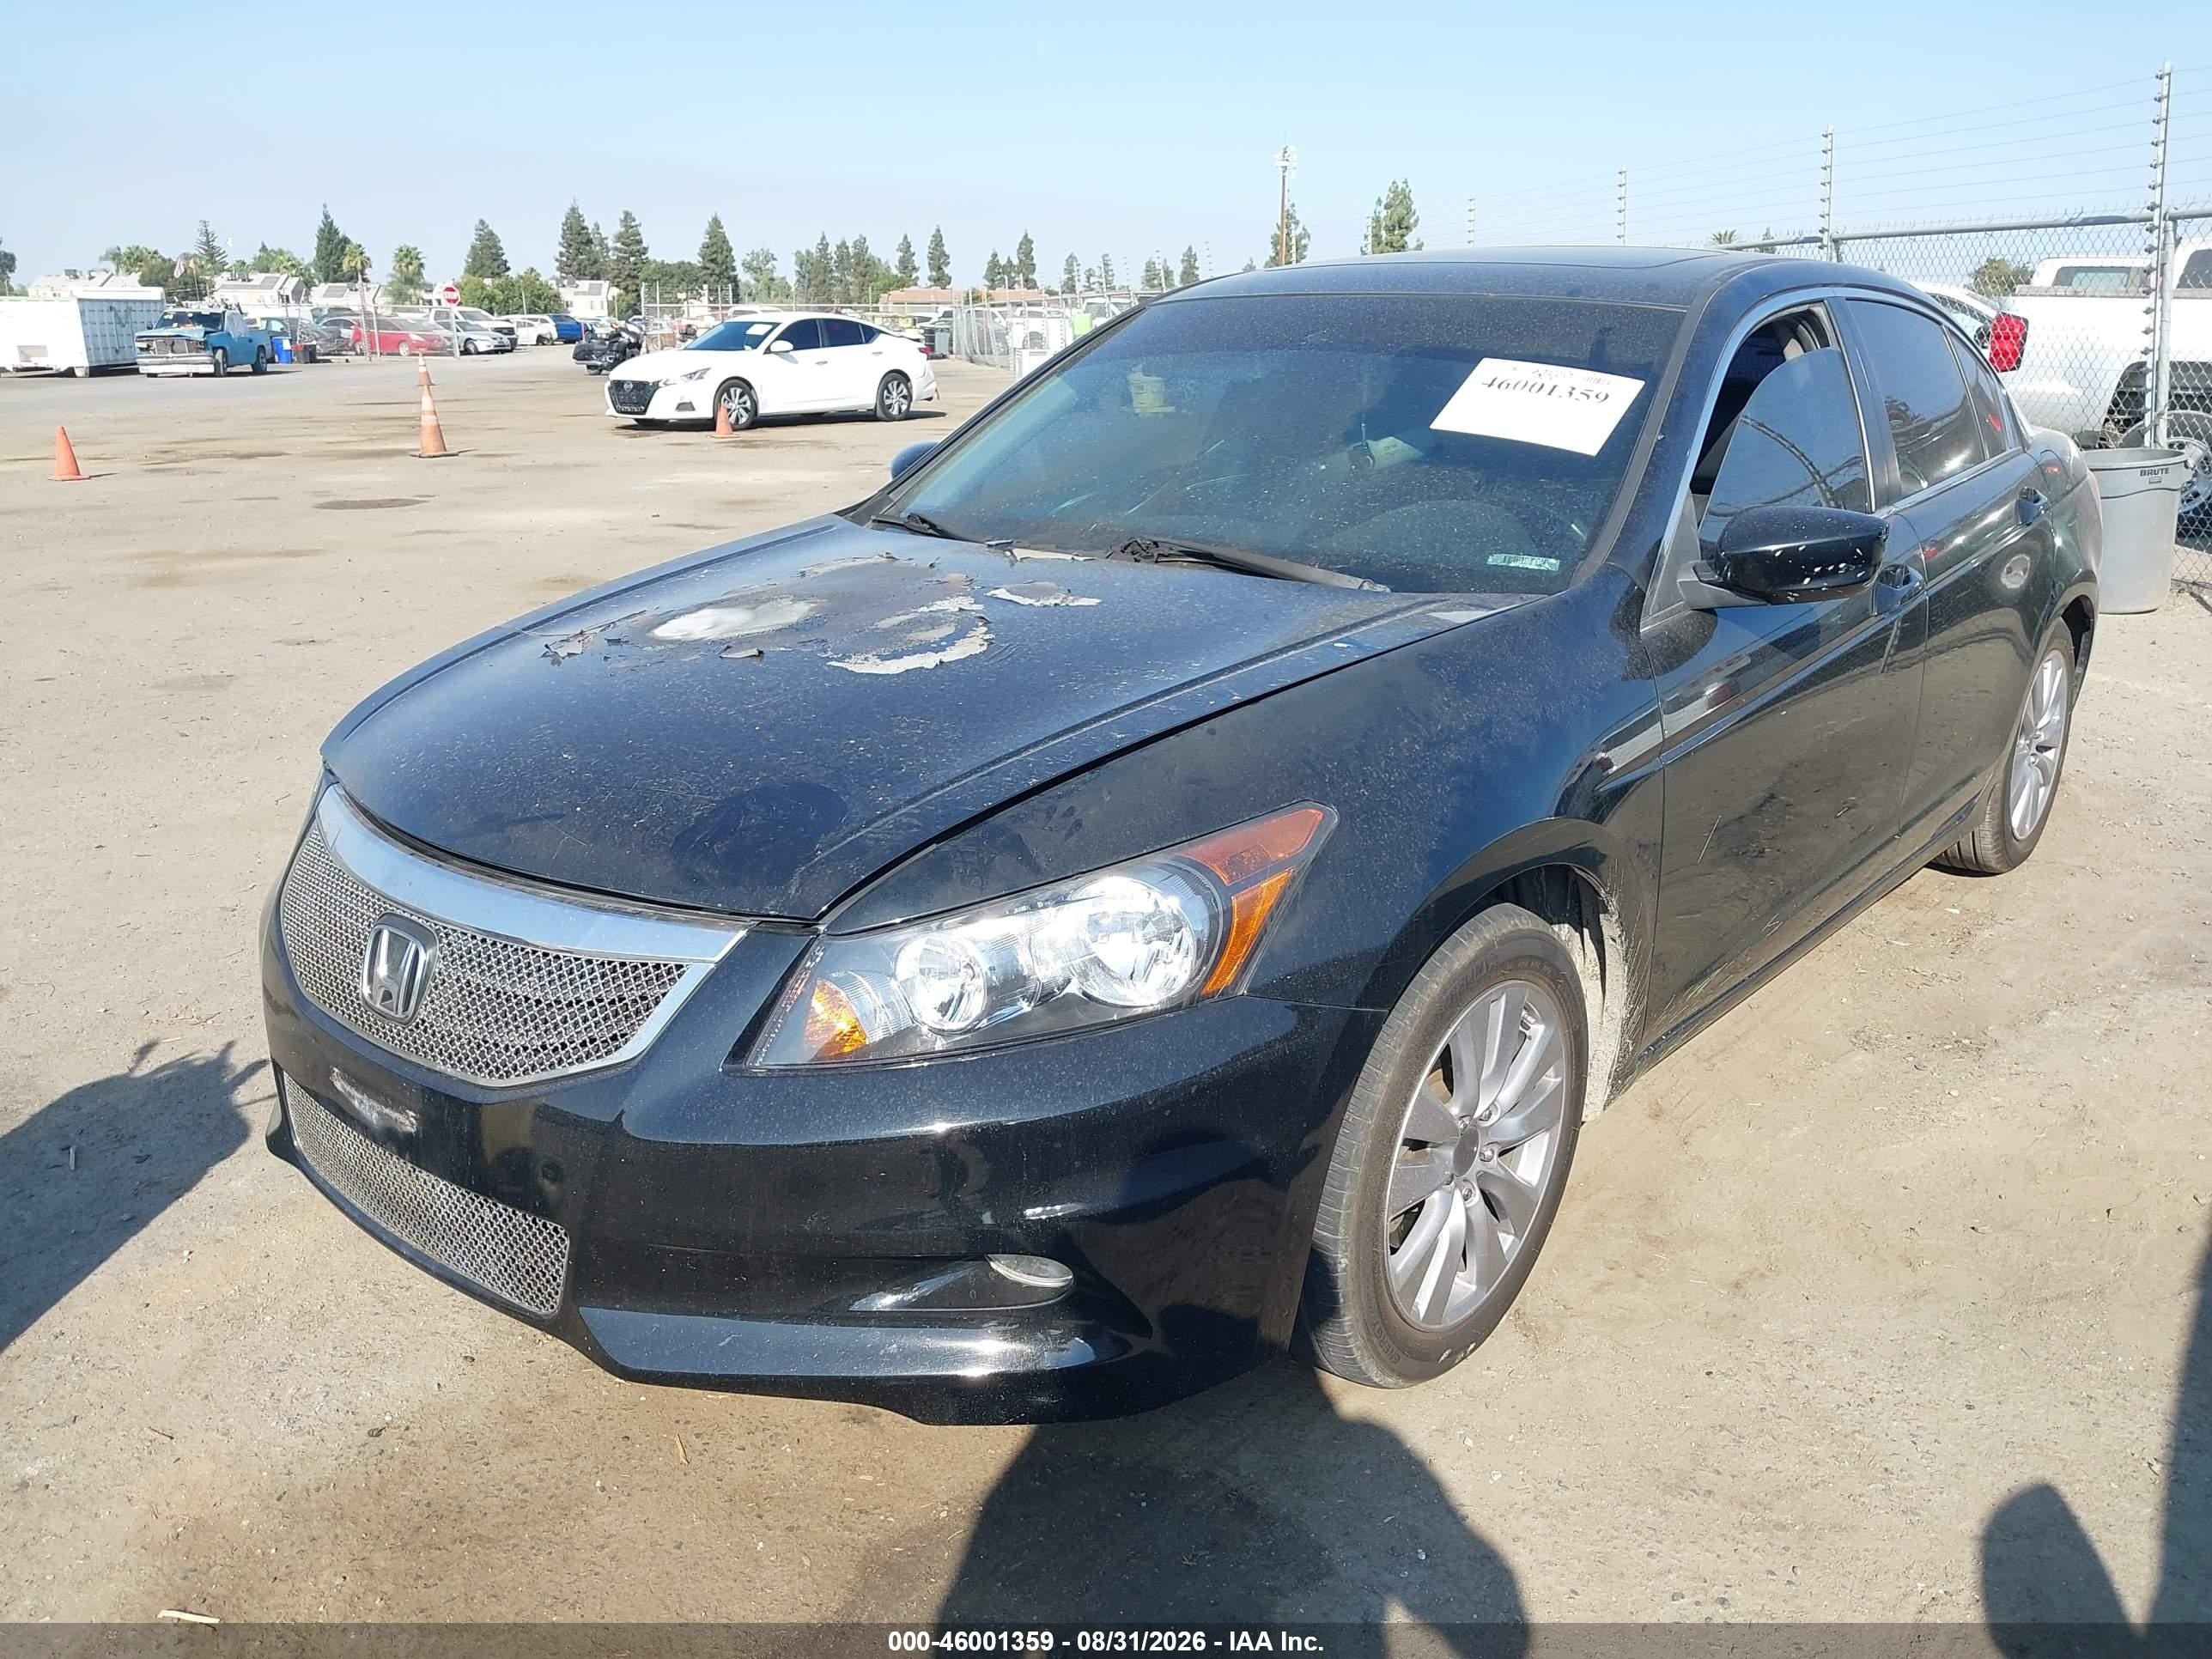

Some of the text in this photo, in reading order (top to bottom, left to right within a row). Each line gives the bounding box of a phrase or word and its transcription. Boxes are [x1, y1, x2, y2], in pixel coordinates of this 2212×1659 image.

[443, 291, 458, 300] STOP
[1481, 376, 1610, 403] 46001359
[2140, 467, 2170, 477] BRUTE
